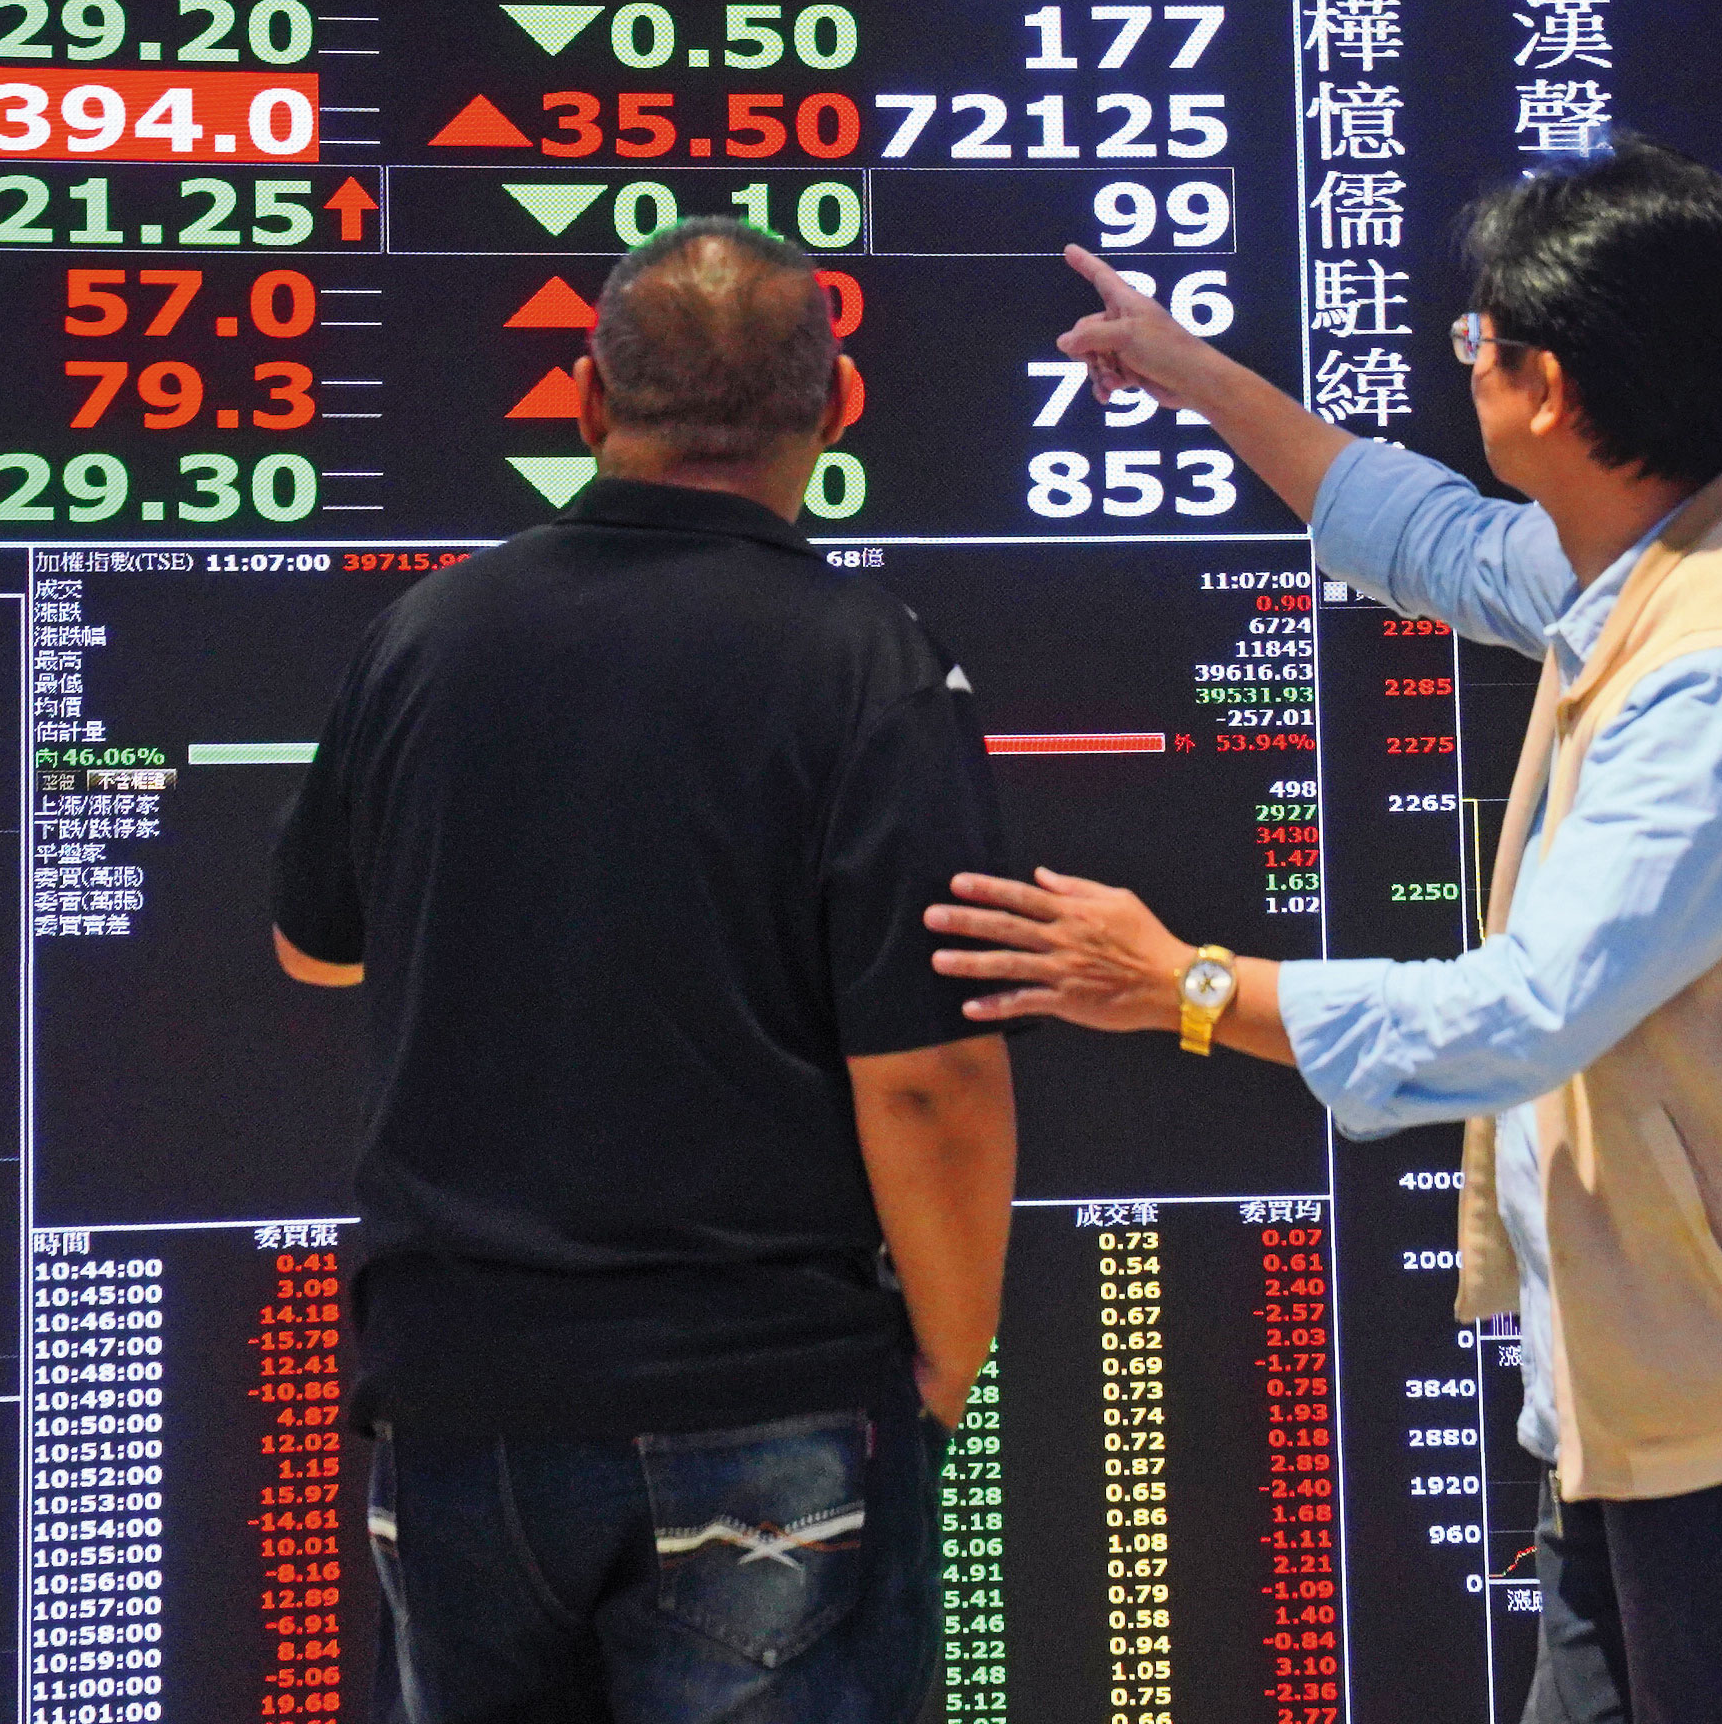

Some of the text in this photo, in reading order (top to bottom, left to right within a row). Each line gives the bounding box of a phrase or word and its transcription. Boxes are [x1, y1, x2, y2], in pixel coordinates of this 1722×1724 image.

[610, 2, 858, 70] 0.50
[1024, 5, 1225, 70] 177
[540, 90, 862, 159] 35.50
[873, 93, 1229, 161] 72125
[1093, 181, 1230, 248] 99
[64, 268, 317, 339] 57.0
[64, 360, 316, 431] 79.3
[1026, 449, 1237, 518] 853
[206, 553, 331, 572] 11:07:00
[1200, 571, 1311, 590] 11:07:00
[1249, 616, 1312, 635] 6724
[1194, 663, 1314, 682] 39616.63
[1384, 677, 1454, 697] 2285
[1216, 733, 1316, 752] 53.94%
[1386, 736, 1456, 755] 2275
[62, 747, 166, 771] 46.06%
[1268, 780, 1318, 799] 498
[1388, 794, 1457, 812] 2265
[1264, 849, 1320, 868] 1.47
[1098, 1228, 1323, 1251] 0.73 0.07
[34, 1252, 338, 1282] 10:44:00 0.41
[1099, 1252, 1324, 1276] 0.54 0.61
[35, 1277, 340, 1308] 10:45:00 3.09
[34, 1329, 340, 1360] 10:47:00 -15.79
[1408, 1428, 1478, 1447] 2880
[1410, 1475, 1480, 1496] 1920
[1428, 1524, 1482, 1545] 960
